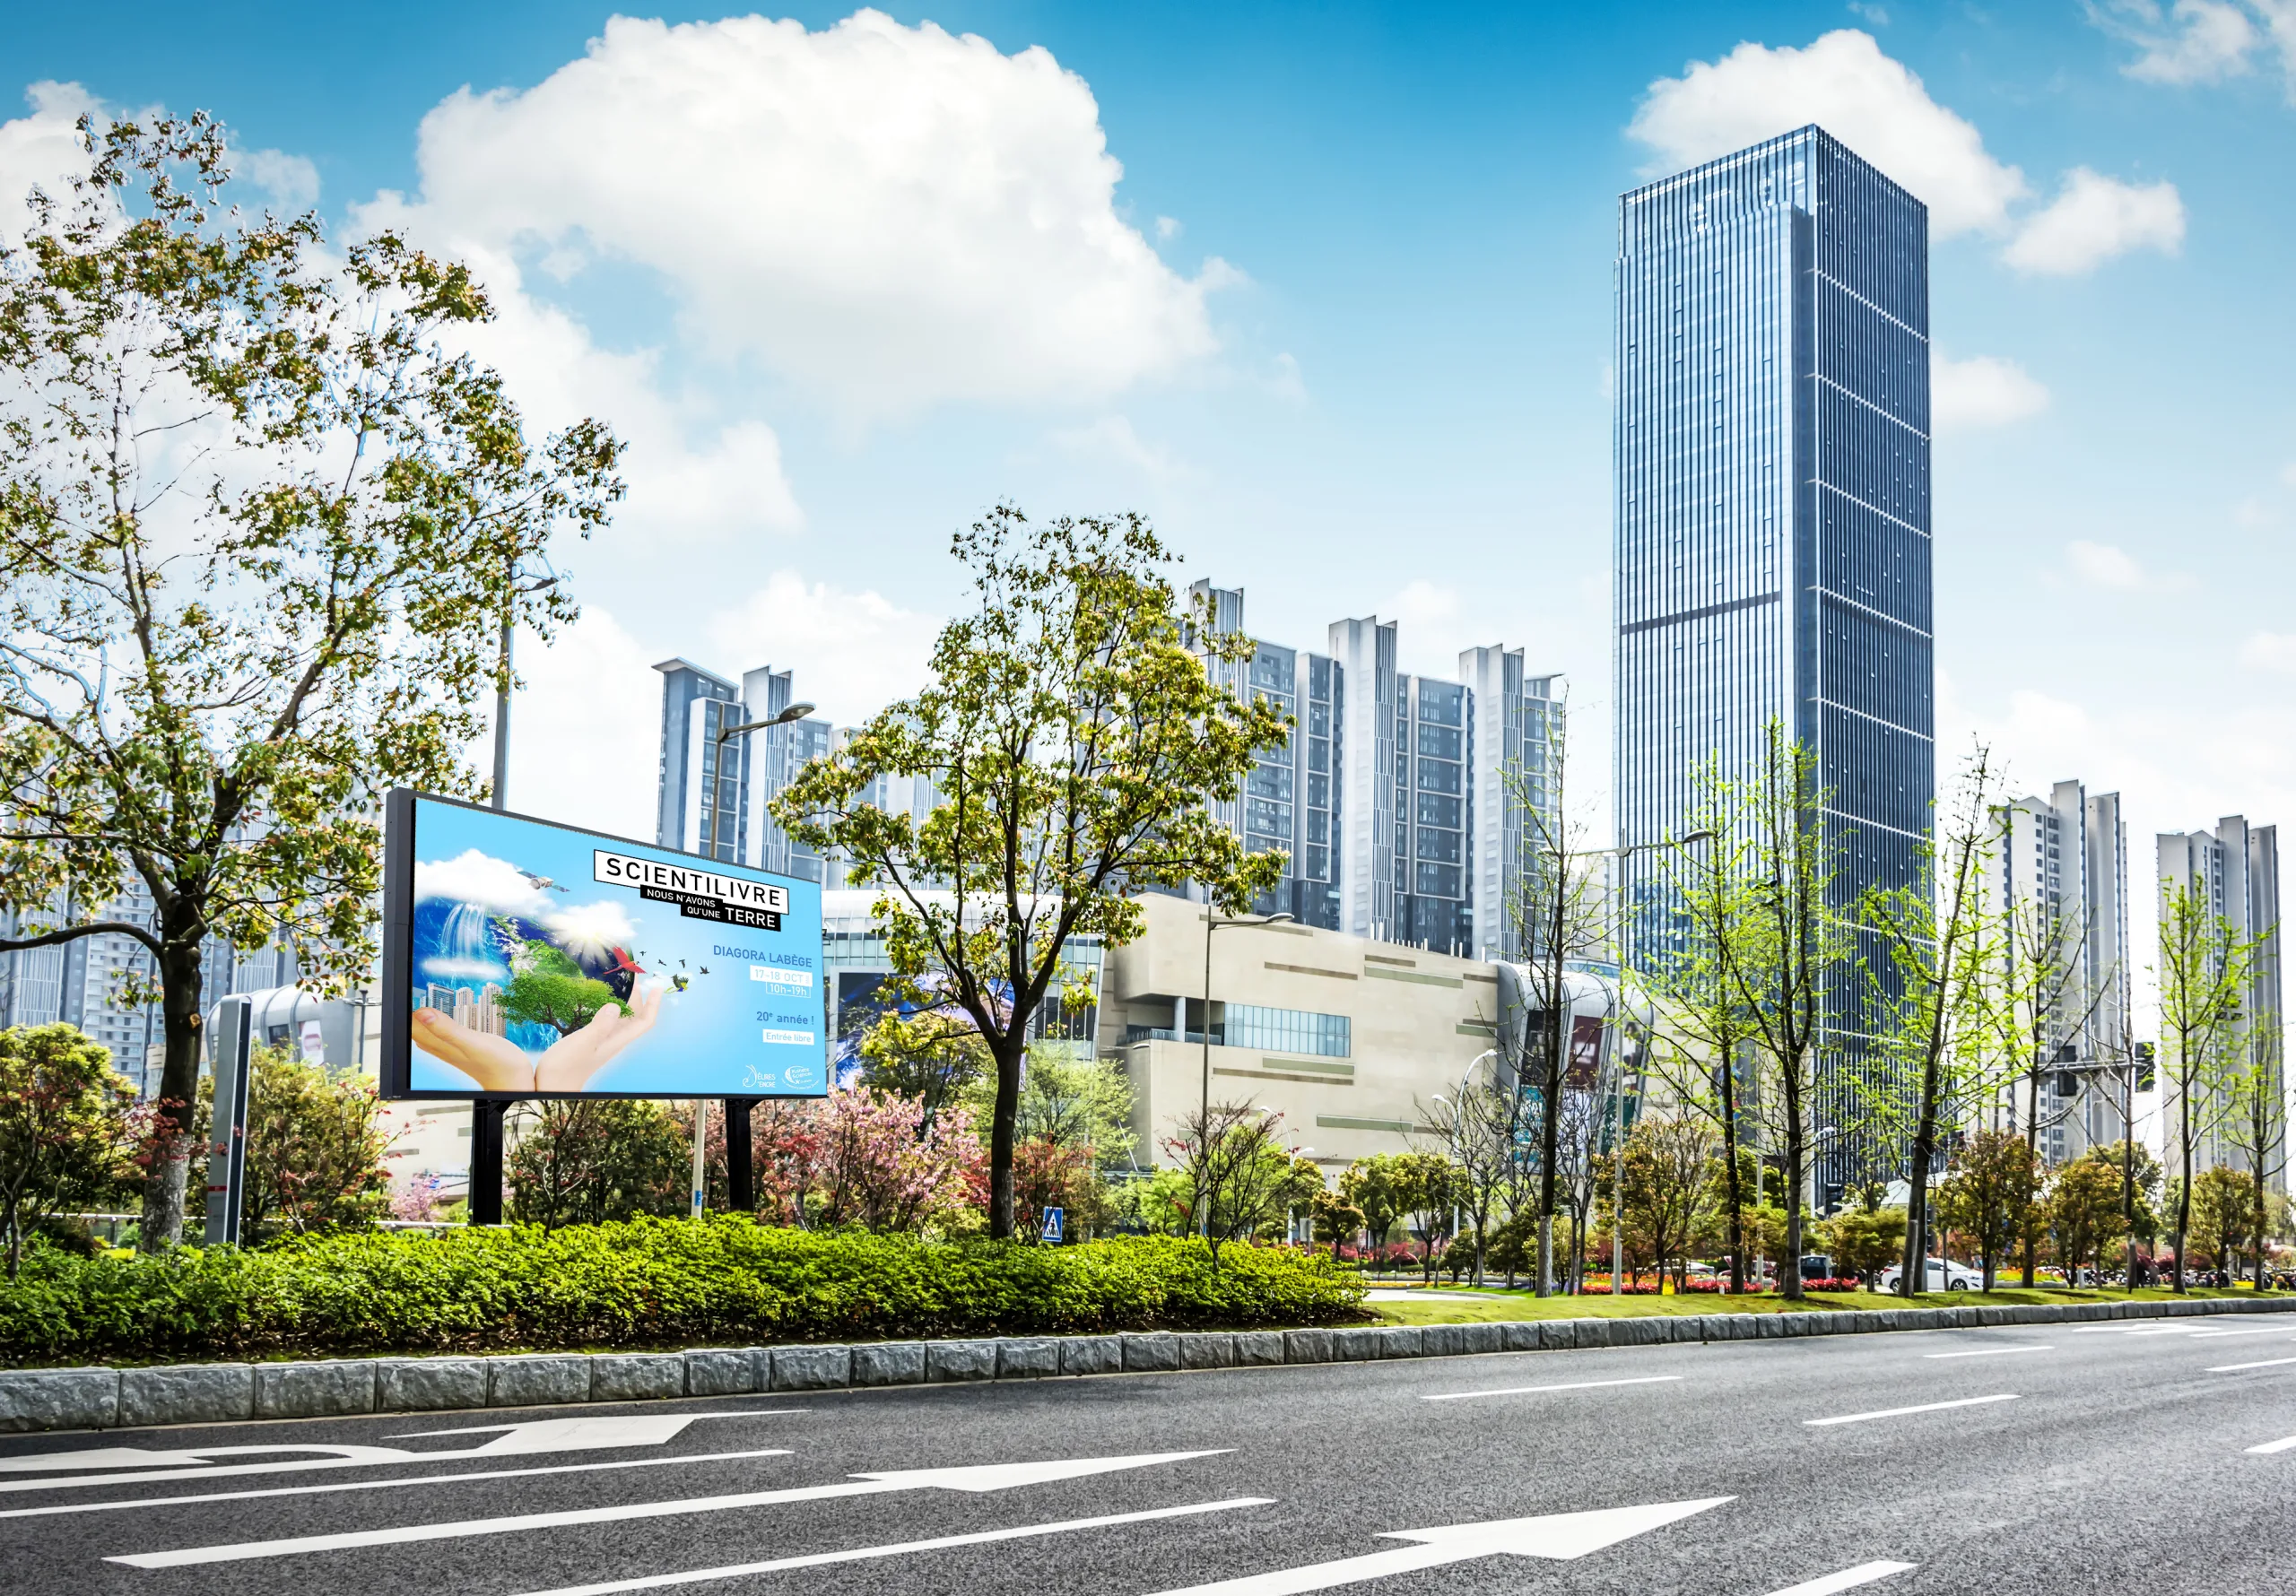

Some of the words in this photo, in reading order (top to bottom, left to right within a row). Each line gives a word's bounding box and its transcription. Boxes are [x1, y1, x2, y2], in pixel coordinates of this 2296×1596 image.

[606, 857, 780, 906] SCIENTILIVRE
[647, 889, 674, 901] NOUS
[676, 894, 716, 907] N'AVONS
[687, 906, 721, 919] QU'UNE
[725, 906, 776, 928] TERRE
[713, 944, 766, 962] DIAGORA
[769, 952, 813, 967] LABÈGE
[755, 968, 780, 981] 17-18
[784, 973, 804, 984] OCT
[770, 983, 807, 996] 10h-19h
[777, 1014, 808, 1025] année
[766, 1032, 792, 1041] Entrée
[794, 1034, 811, 1043] libre
